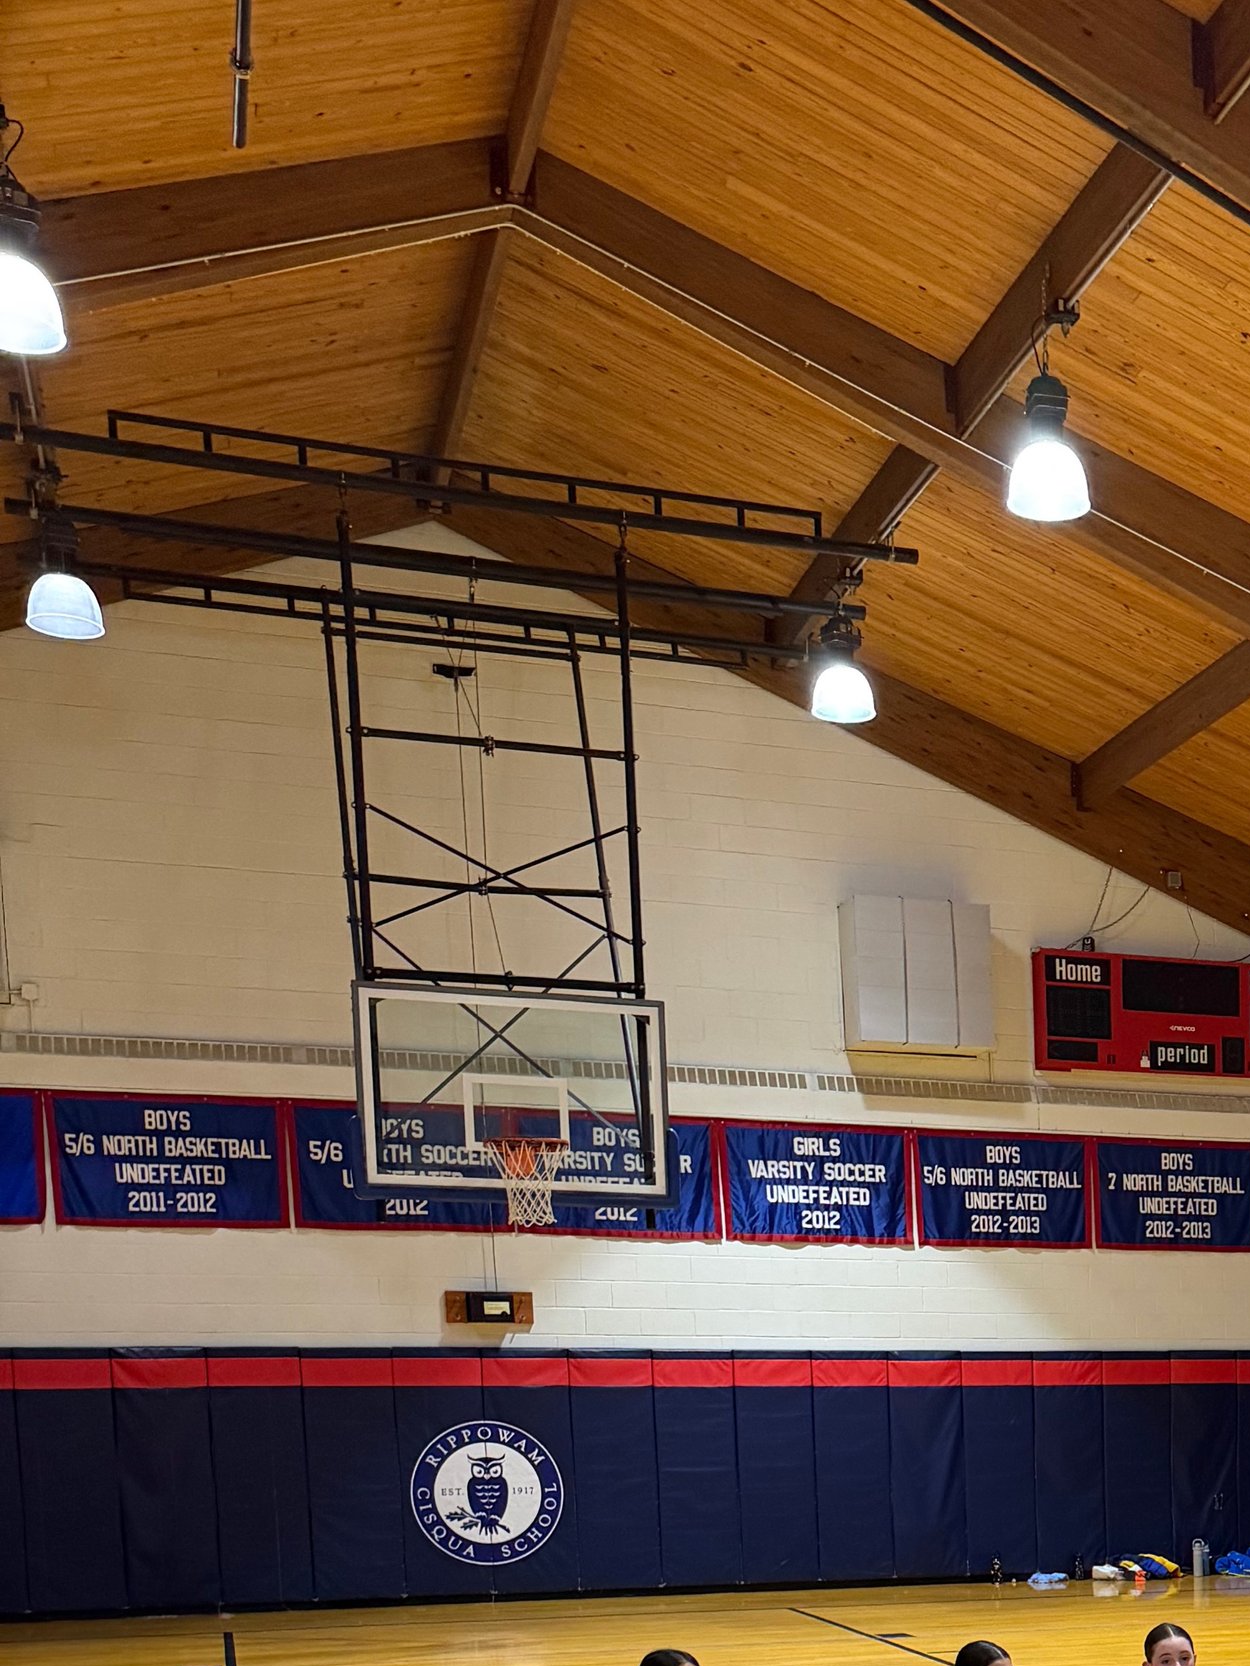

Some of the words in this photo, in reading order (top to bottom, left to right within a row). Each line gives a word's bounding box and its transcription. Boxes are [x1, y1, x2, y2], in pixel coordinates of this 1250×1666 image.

[1055, 958, 1101, 983] Home
[1157, 1045, 1208, 1066] period
[144, 1110, 191, 1131] BOYS
[64, 1132, 95, 1157] 5/6
[102, 1135, 157, 1157] NORTH
[164, 1137, 272, 1160] BASKETBALL
[593, 1127, 640, 1148] BOYS
[793, 1137, 841, 1157] GIRLS
[309, 1140, 343, 1164] 5/6
[421, 1145, 492, 1167] SOCCER
[986, 1145, 1021, 1164] BOYS
[1161, 1153, 1193, 1170] BOYS
[115, 1163, 225, 1186] UNDEFEATED
[748, 1159, 815, 1180] VARSITY
[824, 1163, 886, 1183] SOCCER
[923, 1165, 946, 1187] 5/6
[951, 1167, 993, 1187] NORTH
[999, 1169, 1082, 1189] BASKETBALL
[1108, 1173, 1117, 1190] 7
[1123, 1174, 1162, 1191] NORTH
[1168, 1175, 1245, 1194] BASKETBALL
[128, 1191, 217, 1213] 2011-2012
[766, 1185, 870, 1206] UNDEFEATED
[965, 1191, 1047, 1211] UNDEFEATED
[1139, 1197, 1217, 1215] UNDEFEATED
[385, 1199, 429, 1216] 2012
[801, 1210, 841, 1229] 2012
[971, 1215, 1040, 1233] 2012-2013
[1145, 1220, 1211, 1238] 2012-2013
[425, 1426, 545, 1468] RIPPOWAM
[441, 1487, 465, 1496] EST.
[512, 1486, 534, 1495] 1917
[417, 1487, 475, 1558] CISQUA
[501, 1482, 557, 1558] SCHOOL
